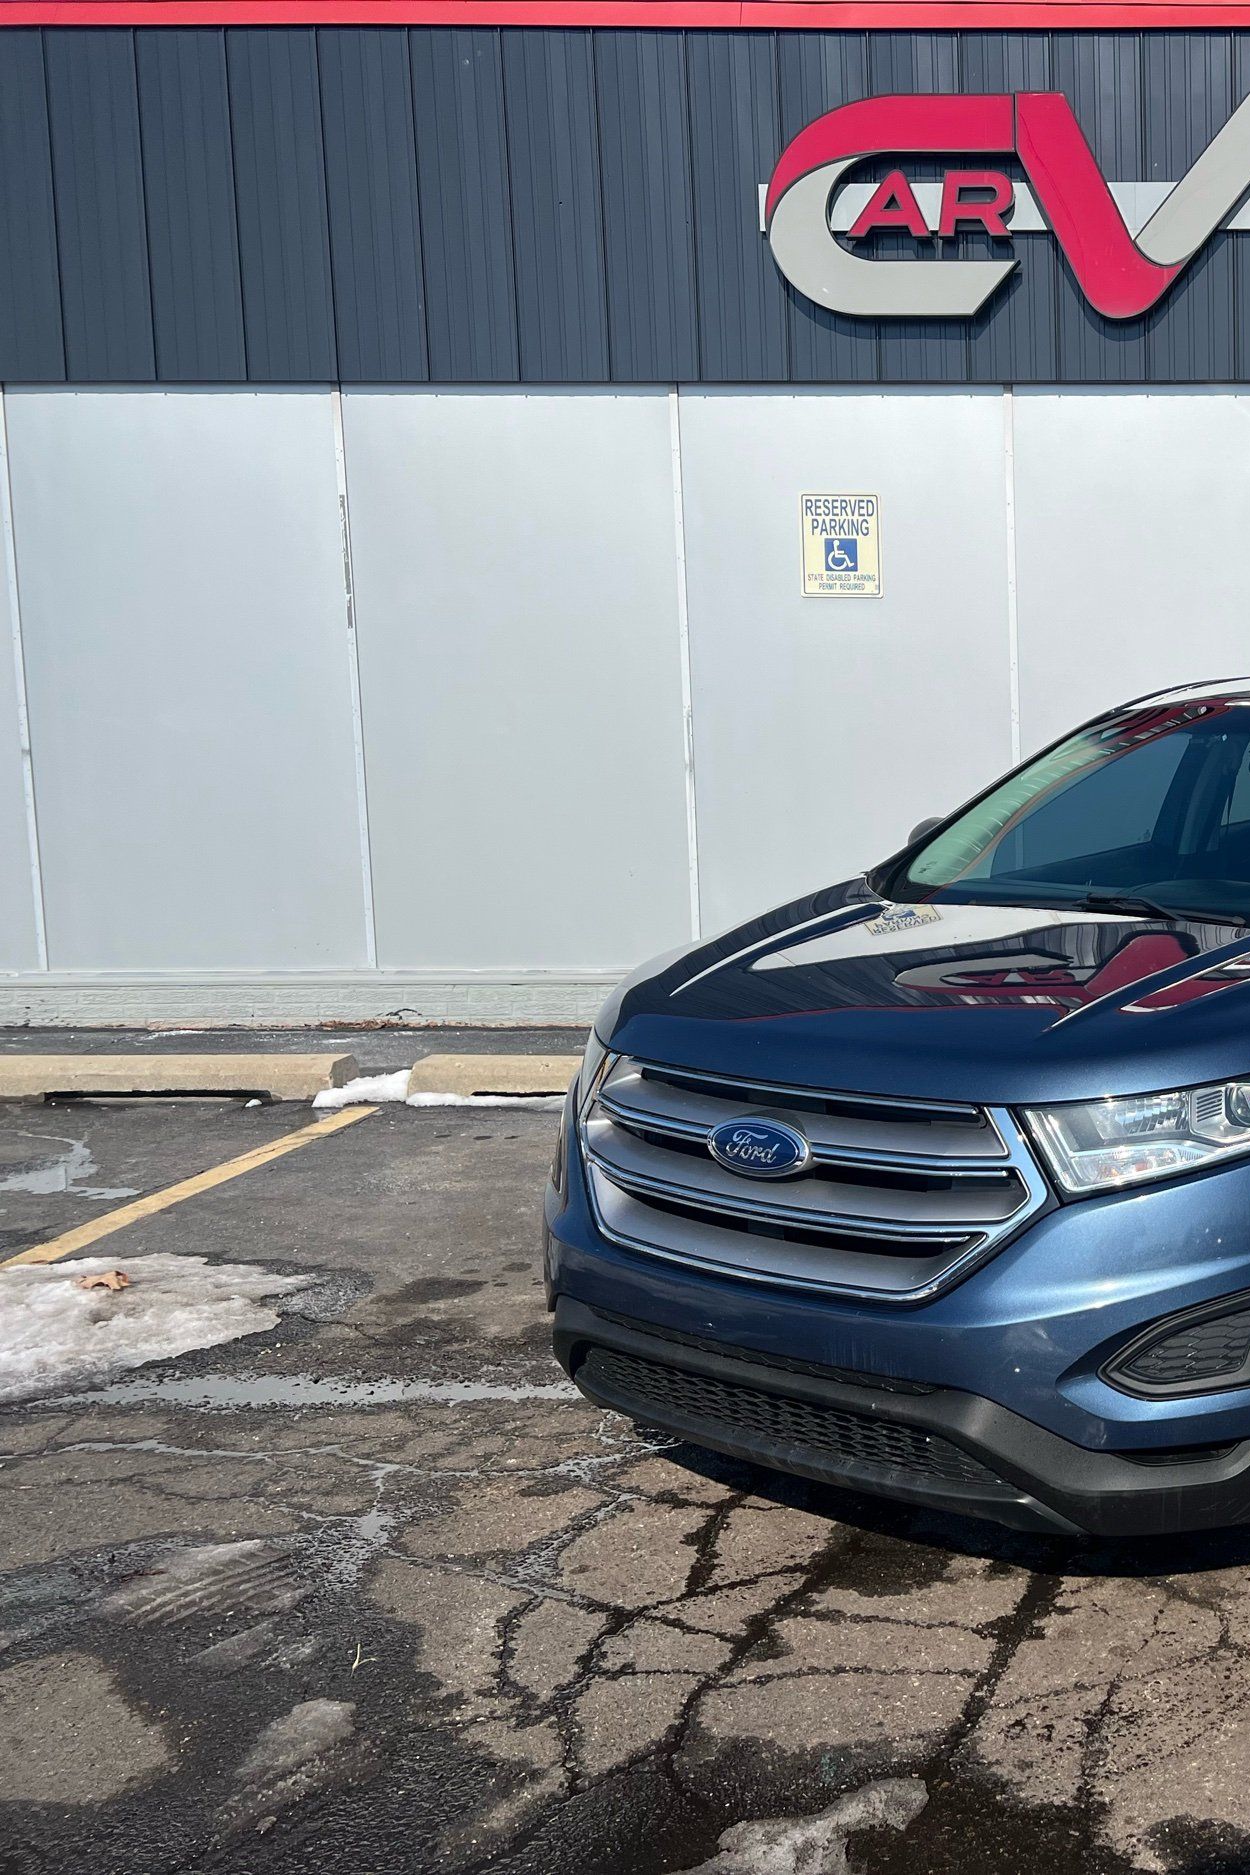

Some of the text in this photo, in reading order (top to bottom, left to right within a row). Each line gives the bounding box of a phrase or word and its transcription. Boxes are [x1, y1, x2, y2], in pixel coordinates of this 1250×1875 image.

[805, 499, 875, 517] RESERVED
[811, 519, 870, 537] PARKING
[808, 574, 876, 582] STATE DISABLED PARKING
[818, 583, 866, 591] PERMIT REQUIRED
[725, 1129, 780, 1163] Ford
